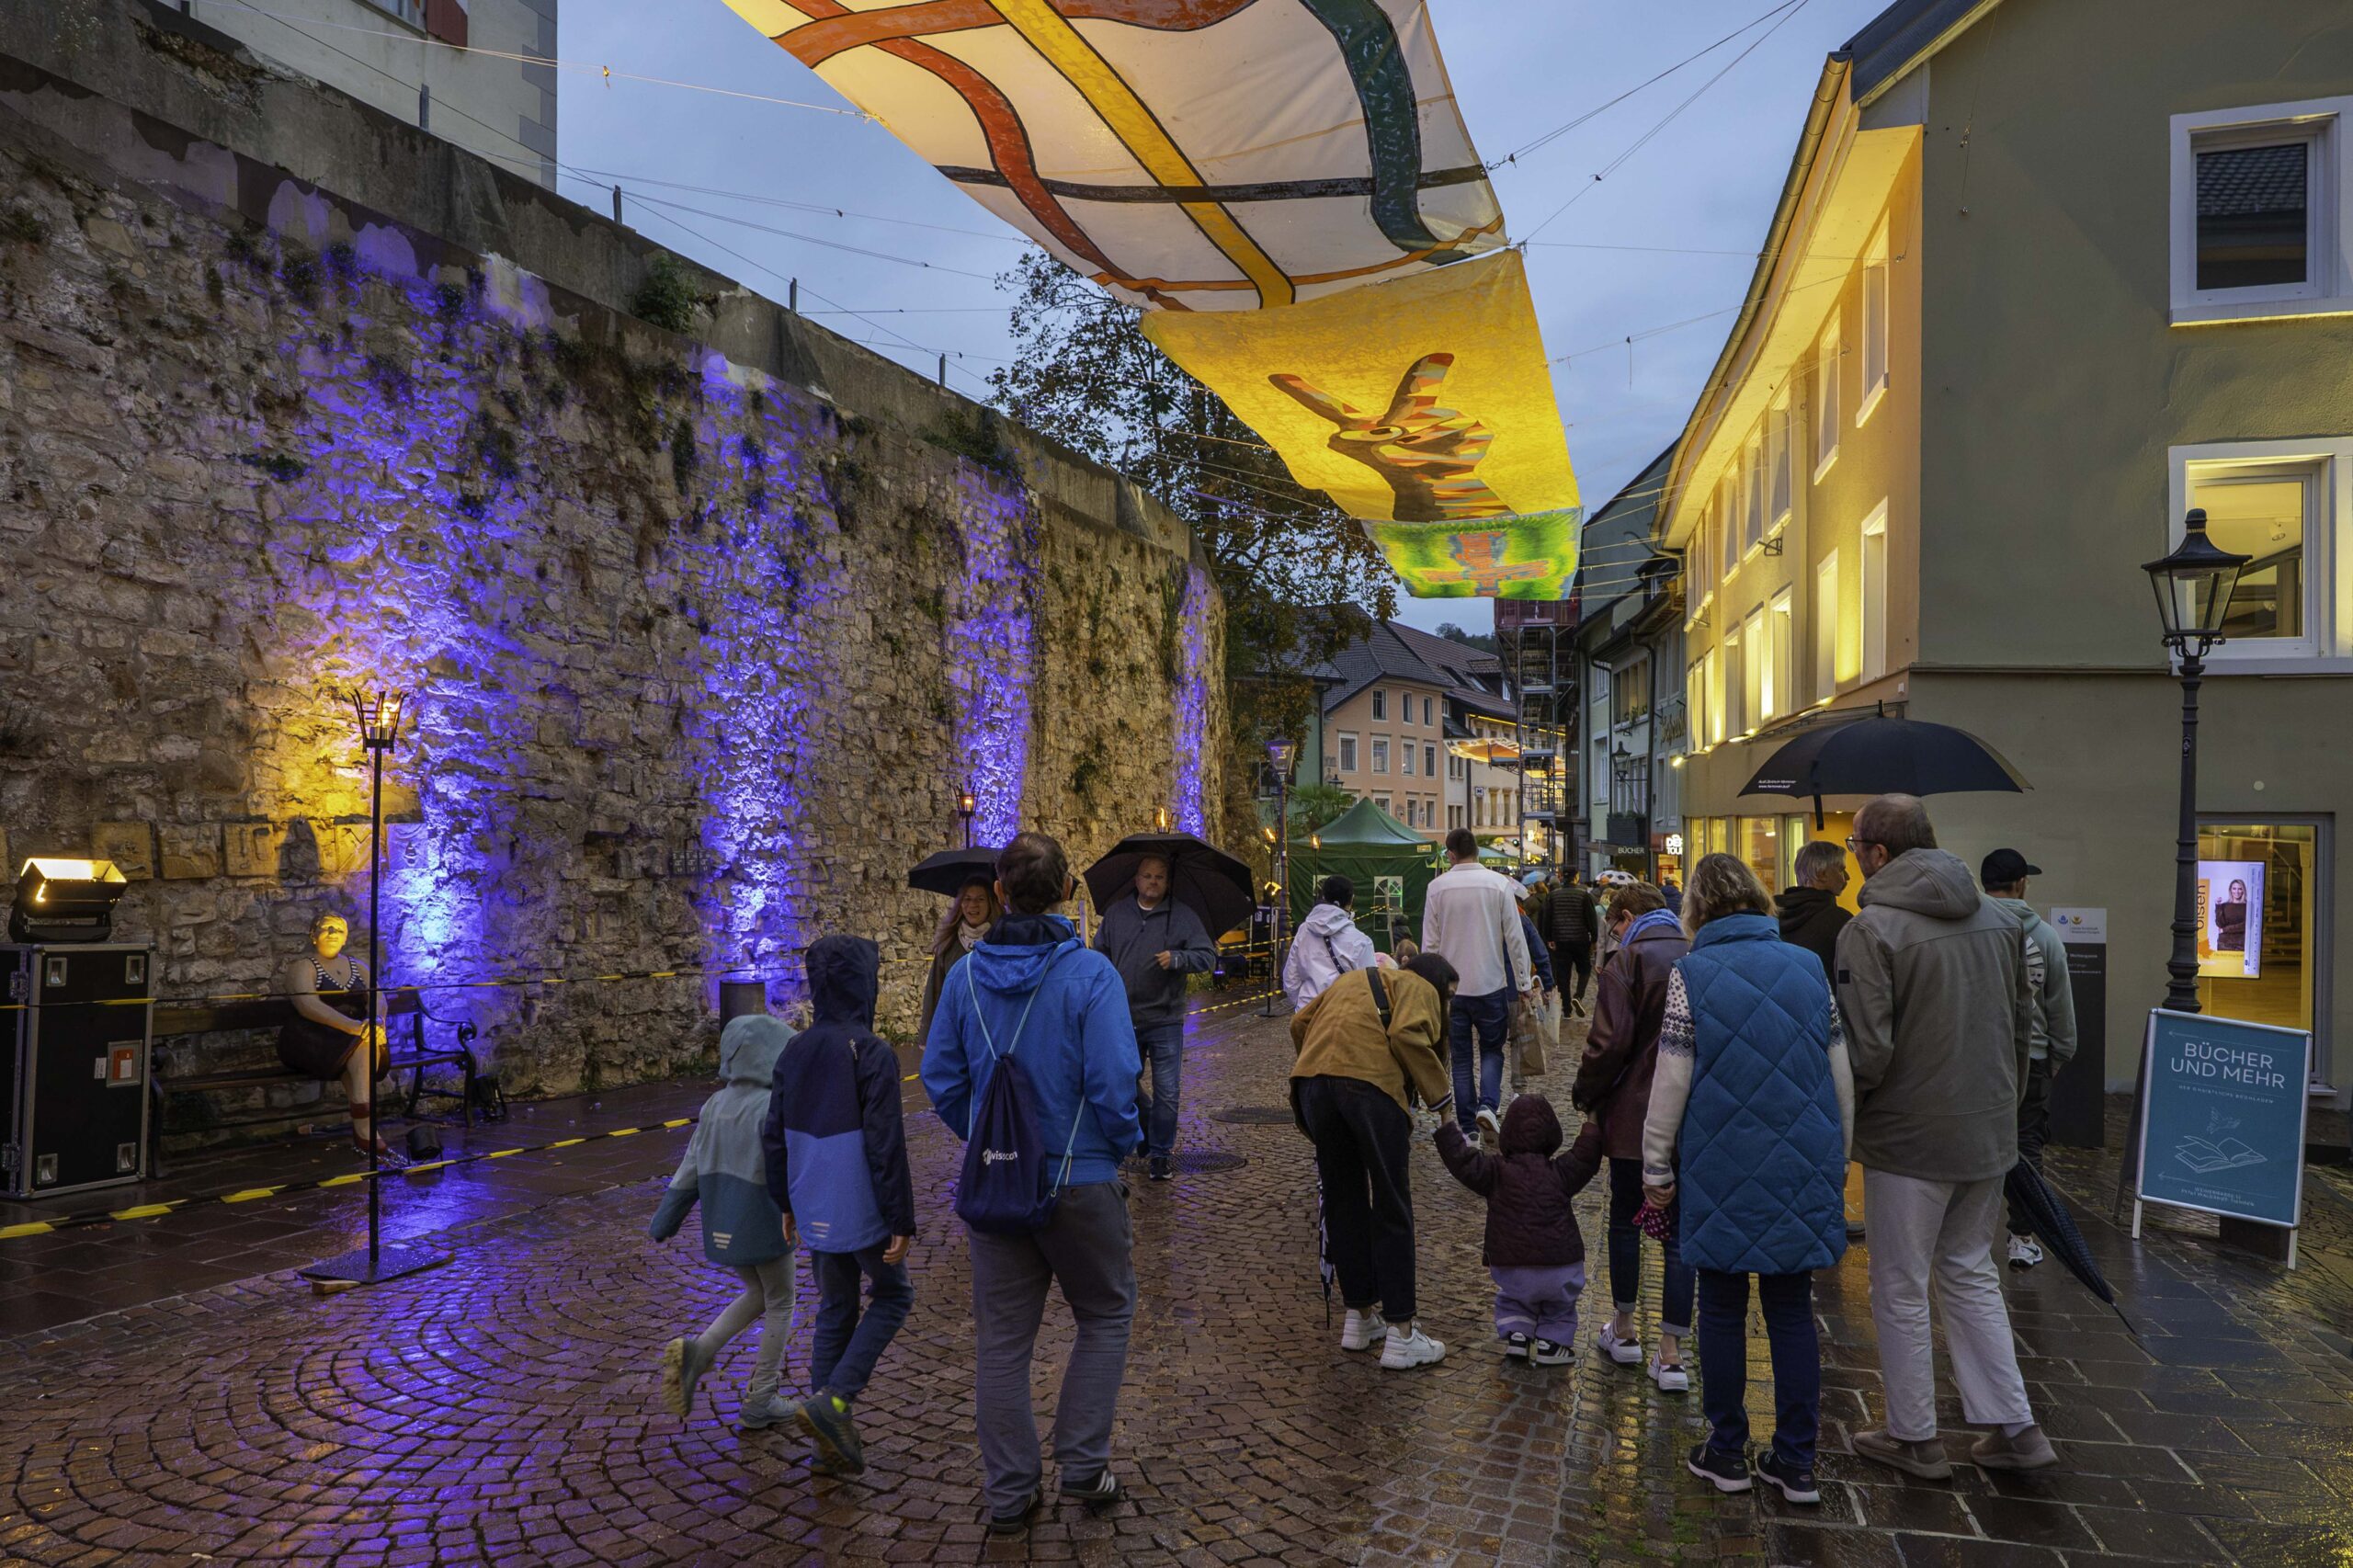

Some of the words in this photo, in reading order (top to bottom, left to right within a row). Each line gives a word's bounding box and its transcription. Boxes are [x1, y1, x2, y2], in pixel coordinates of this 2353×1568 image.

[1618, 846, 1645, 854] BÜCHER
[2185, 1041, 2273, 1069] BÜCHER
[2171, 1057, 2216, 1077] UND
[2222, 1065, 2285, 1088] MEHR
